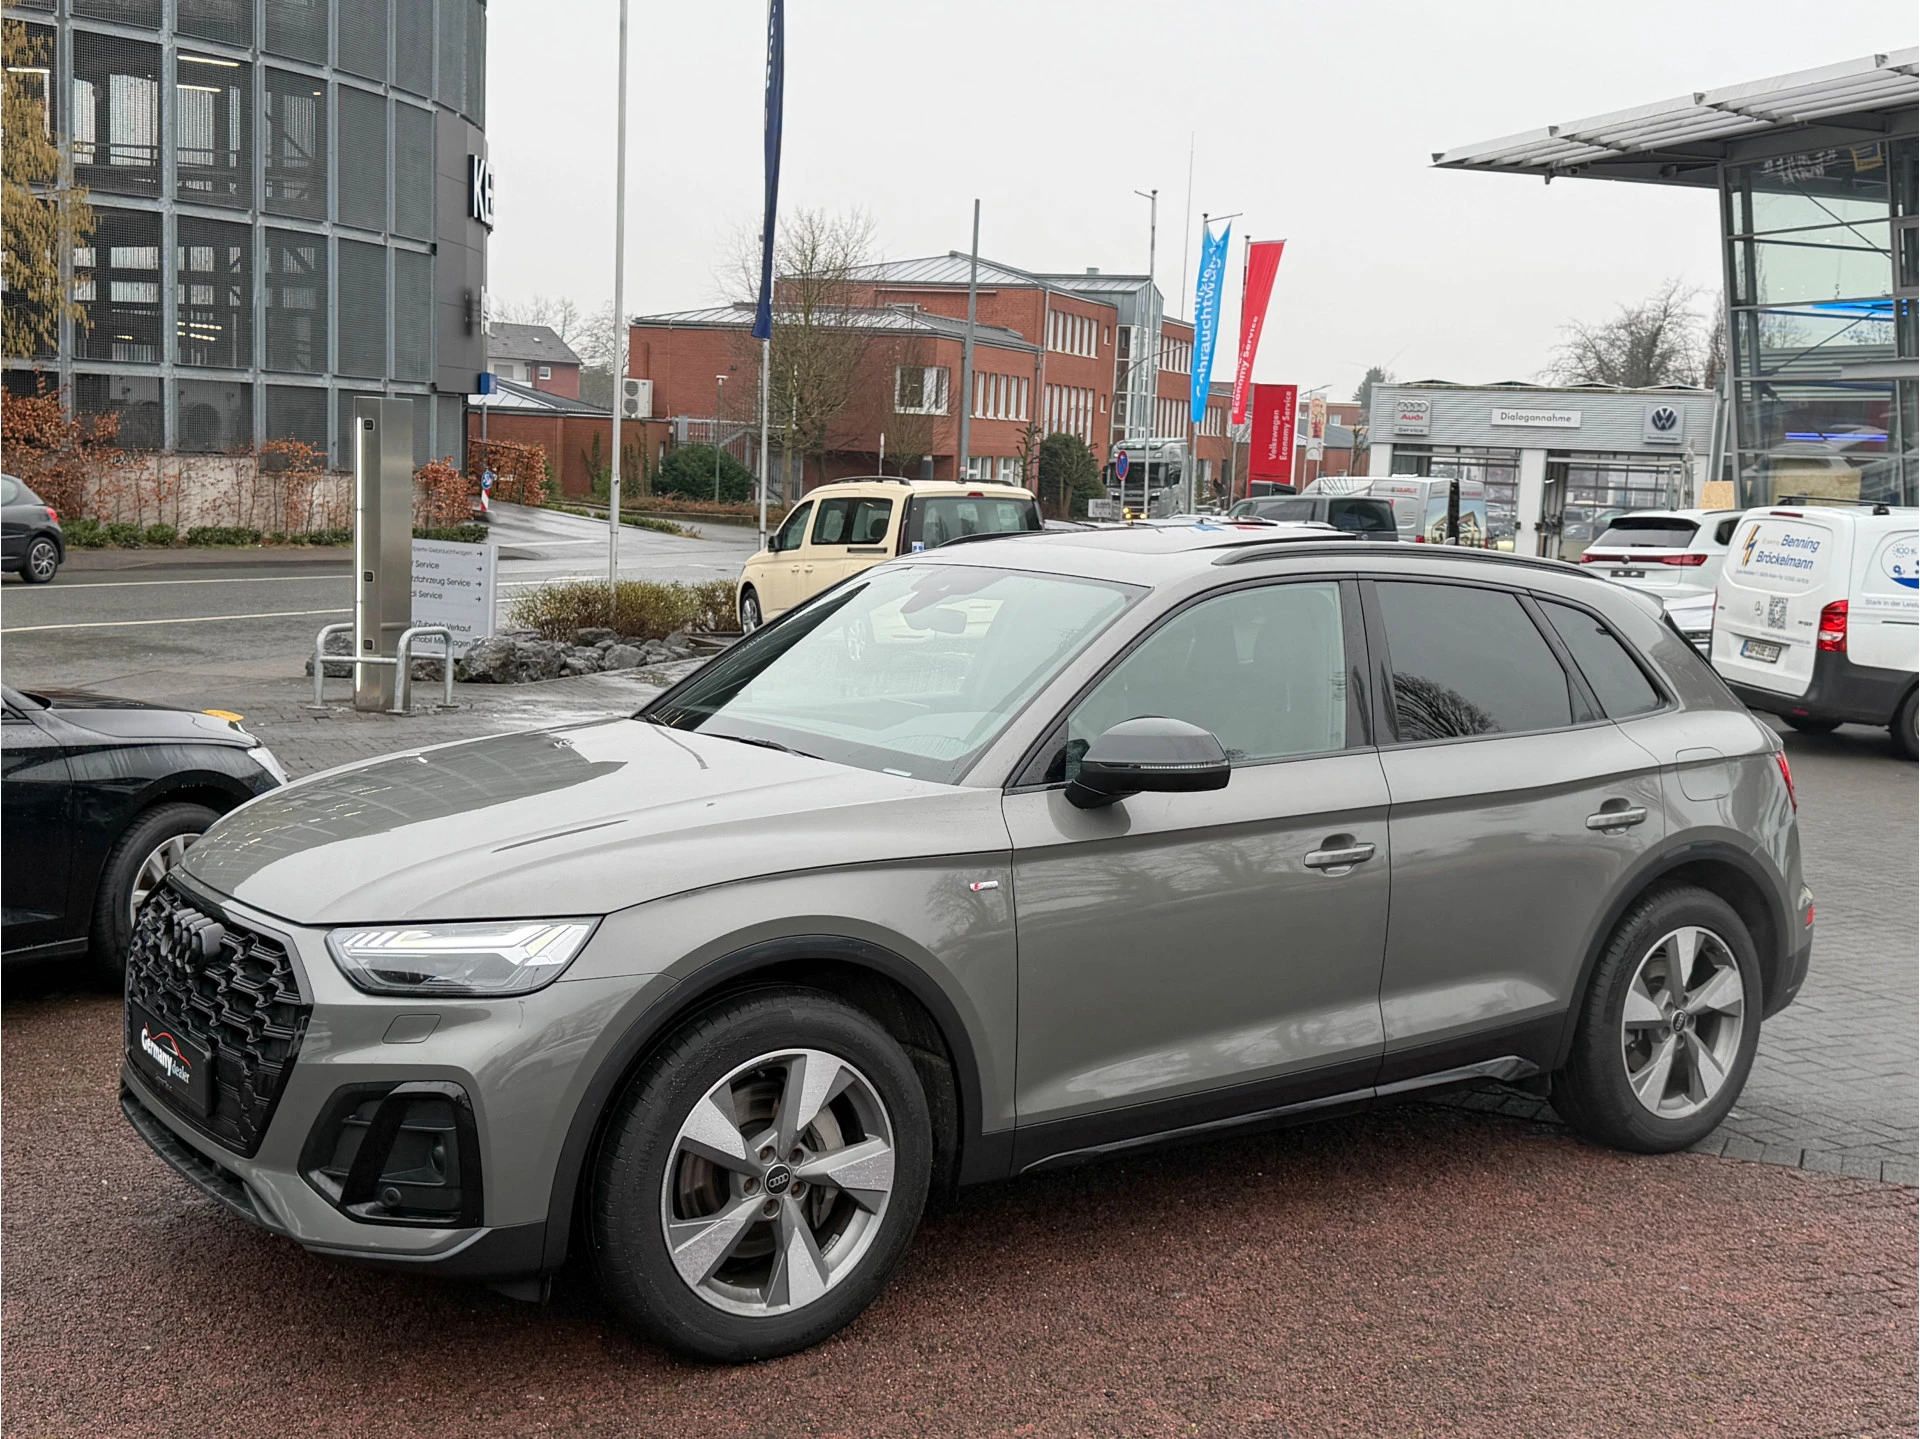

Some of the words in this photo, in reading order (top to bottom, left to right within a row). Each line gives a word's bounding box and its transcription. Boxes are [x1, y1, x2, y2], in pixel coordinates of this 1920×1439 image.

[1281, 390, 1292, 421] Service
[1400, 413, 1424, 421] Audi
[1500, 411, 1572, 423] Dialogannahme
[1268, 409, 1280, 460] Volkswagen
[1279, 423, 1291, 460] Economy
[1781, 534, 1820, 554] Benning
[415, 560, 440, 570] Service
[1756, 550, 1813, 570] Bröckelmann
[446, 578, 471, 587] Service
[418, 590, 443, 599] Service
[141, 1028, 173, 1077] Germany
